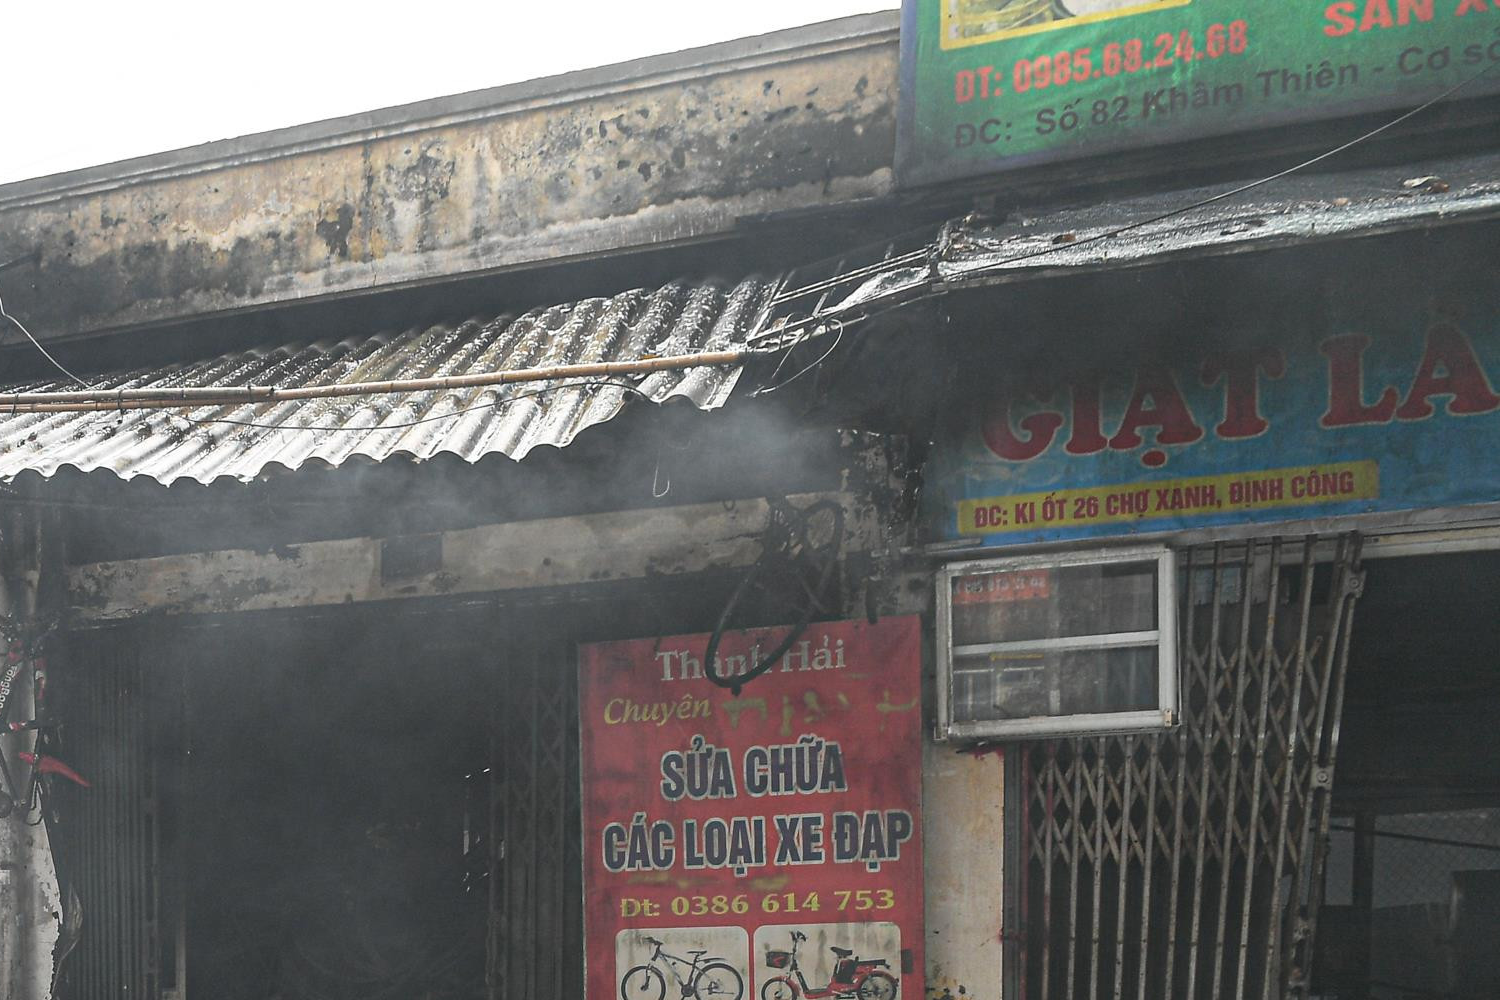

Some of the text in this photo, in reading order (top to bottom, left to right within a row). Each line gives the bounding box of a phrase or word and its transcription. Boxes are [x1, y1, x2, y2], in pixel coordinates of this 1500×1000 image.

[1012, 19, 1249, 95] 0985.68.24.68
[1035, 101, 1080, 136] Số
[1092, 95, 1131, 126] 82
[1257, 61, 1360, 100] Thiên
[1399, 46, 1450, 75] Cơ
[981, 348, 1286, 467] GIẠT
[973, 469, 1355, 528] ĐC: KI ỐT 26 CHỢ XANH, ĐỊNH CÔNG
[604, 694, 712, 726] Chuyên
[661, 734, 848, 800] SỬA CHỮA
[602, 809, 912, 877] CÁC LOẠI XE ĐẠP
[620, 889, 896, 917] Đt: 0386 614 753
